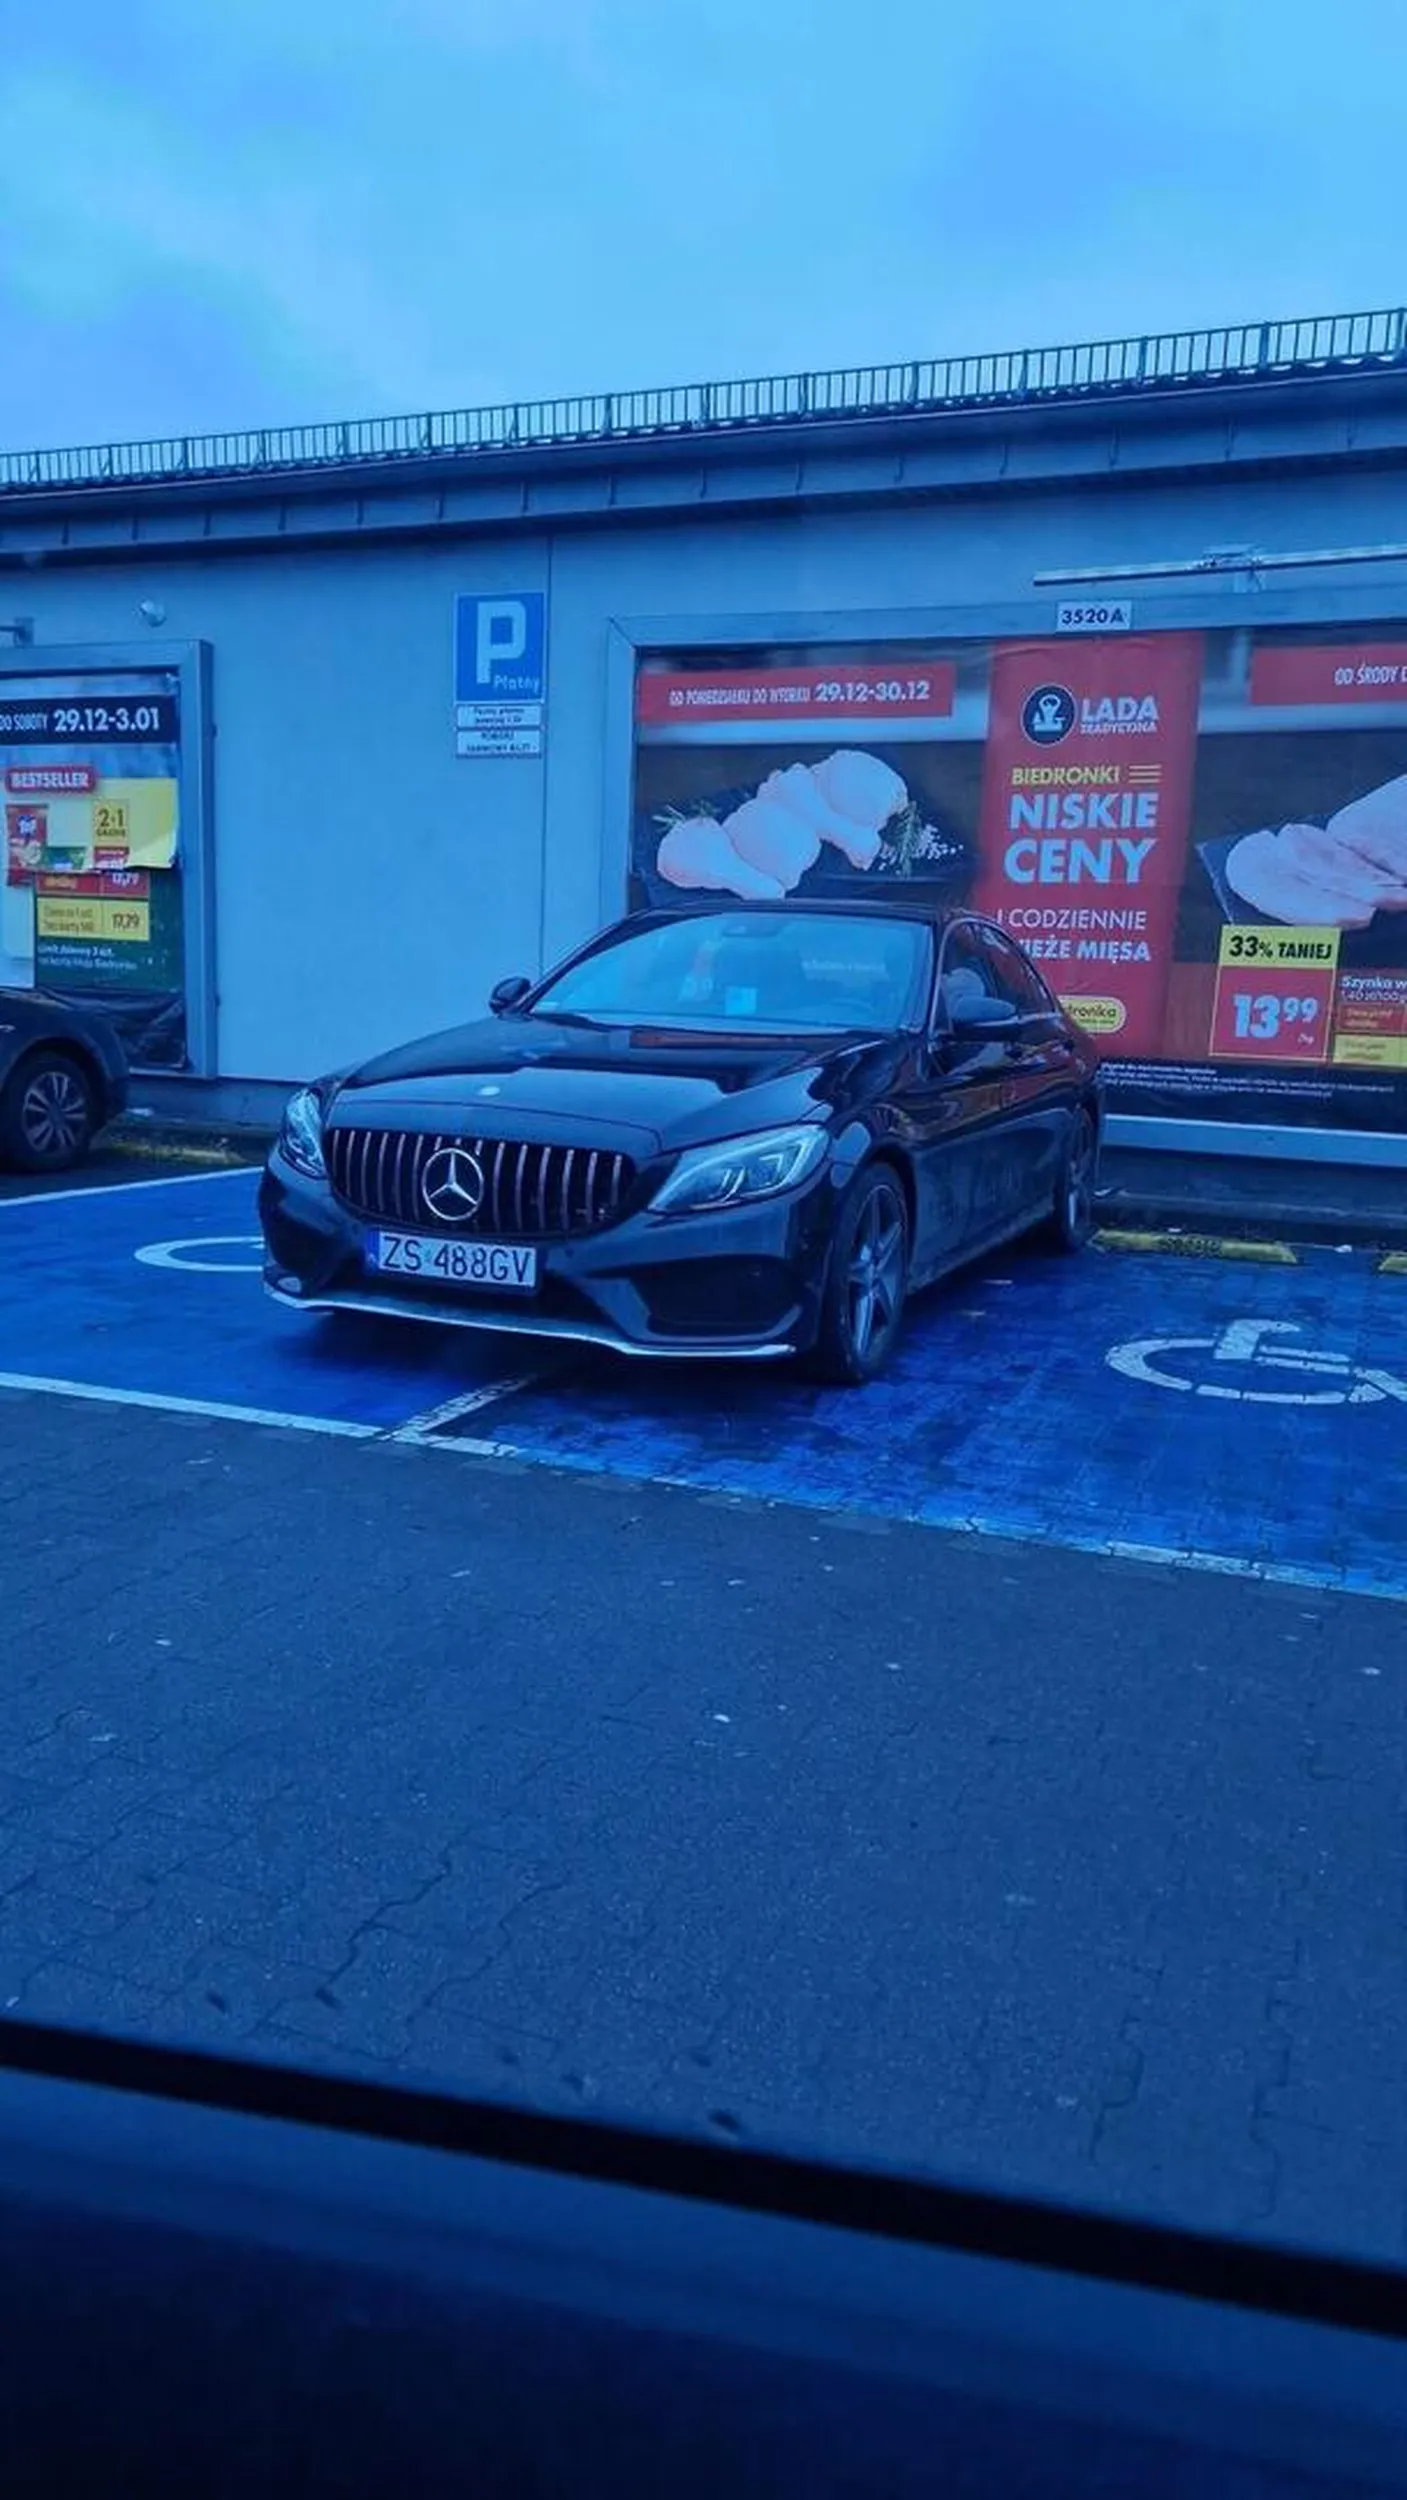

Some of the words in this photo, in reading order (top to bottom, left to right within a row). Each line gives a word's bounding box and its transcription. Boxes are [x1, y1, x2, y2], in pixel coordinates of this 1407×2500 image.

[476, 601, 526, 684] P
[1335, 667, 1354, 686] OD
[1356, 663, 1400, 685] ŚRODY
[814, 680, 930, 703] 29.12-30.12
[13, 712, 48, 731] SOBOTY
[53, 707, 160, 732] 29.12-3.01
[1081, 696, 1159, 721] LADA
[10, 771, 90, 788] BESTSELLER
[1011, 765, 1120, 786] BIEDRONKI
[1010, 791, 1159, 830] NISKIE
[1004, 837, 1158, 884] CENY
[1008, 908, 1147, 930] CODZIENNIE
[1018, 933, 1071, 959] IEŻE
[1077, 939, 1152, 964] MIĘSA
[1229, 935, 1274, 958] 33%
[1277, 942, 1332, 960] TANIEJ
[1341, 975, 1394, 990] Szynka
[1068, 1003, 1117, 1018] ronka
[384, 1236, 422, 1271] ZS
[434, 1243, 531, 1283] 488GV
